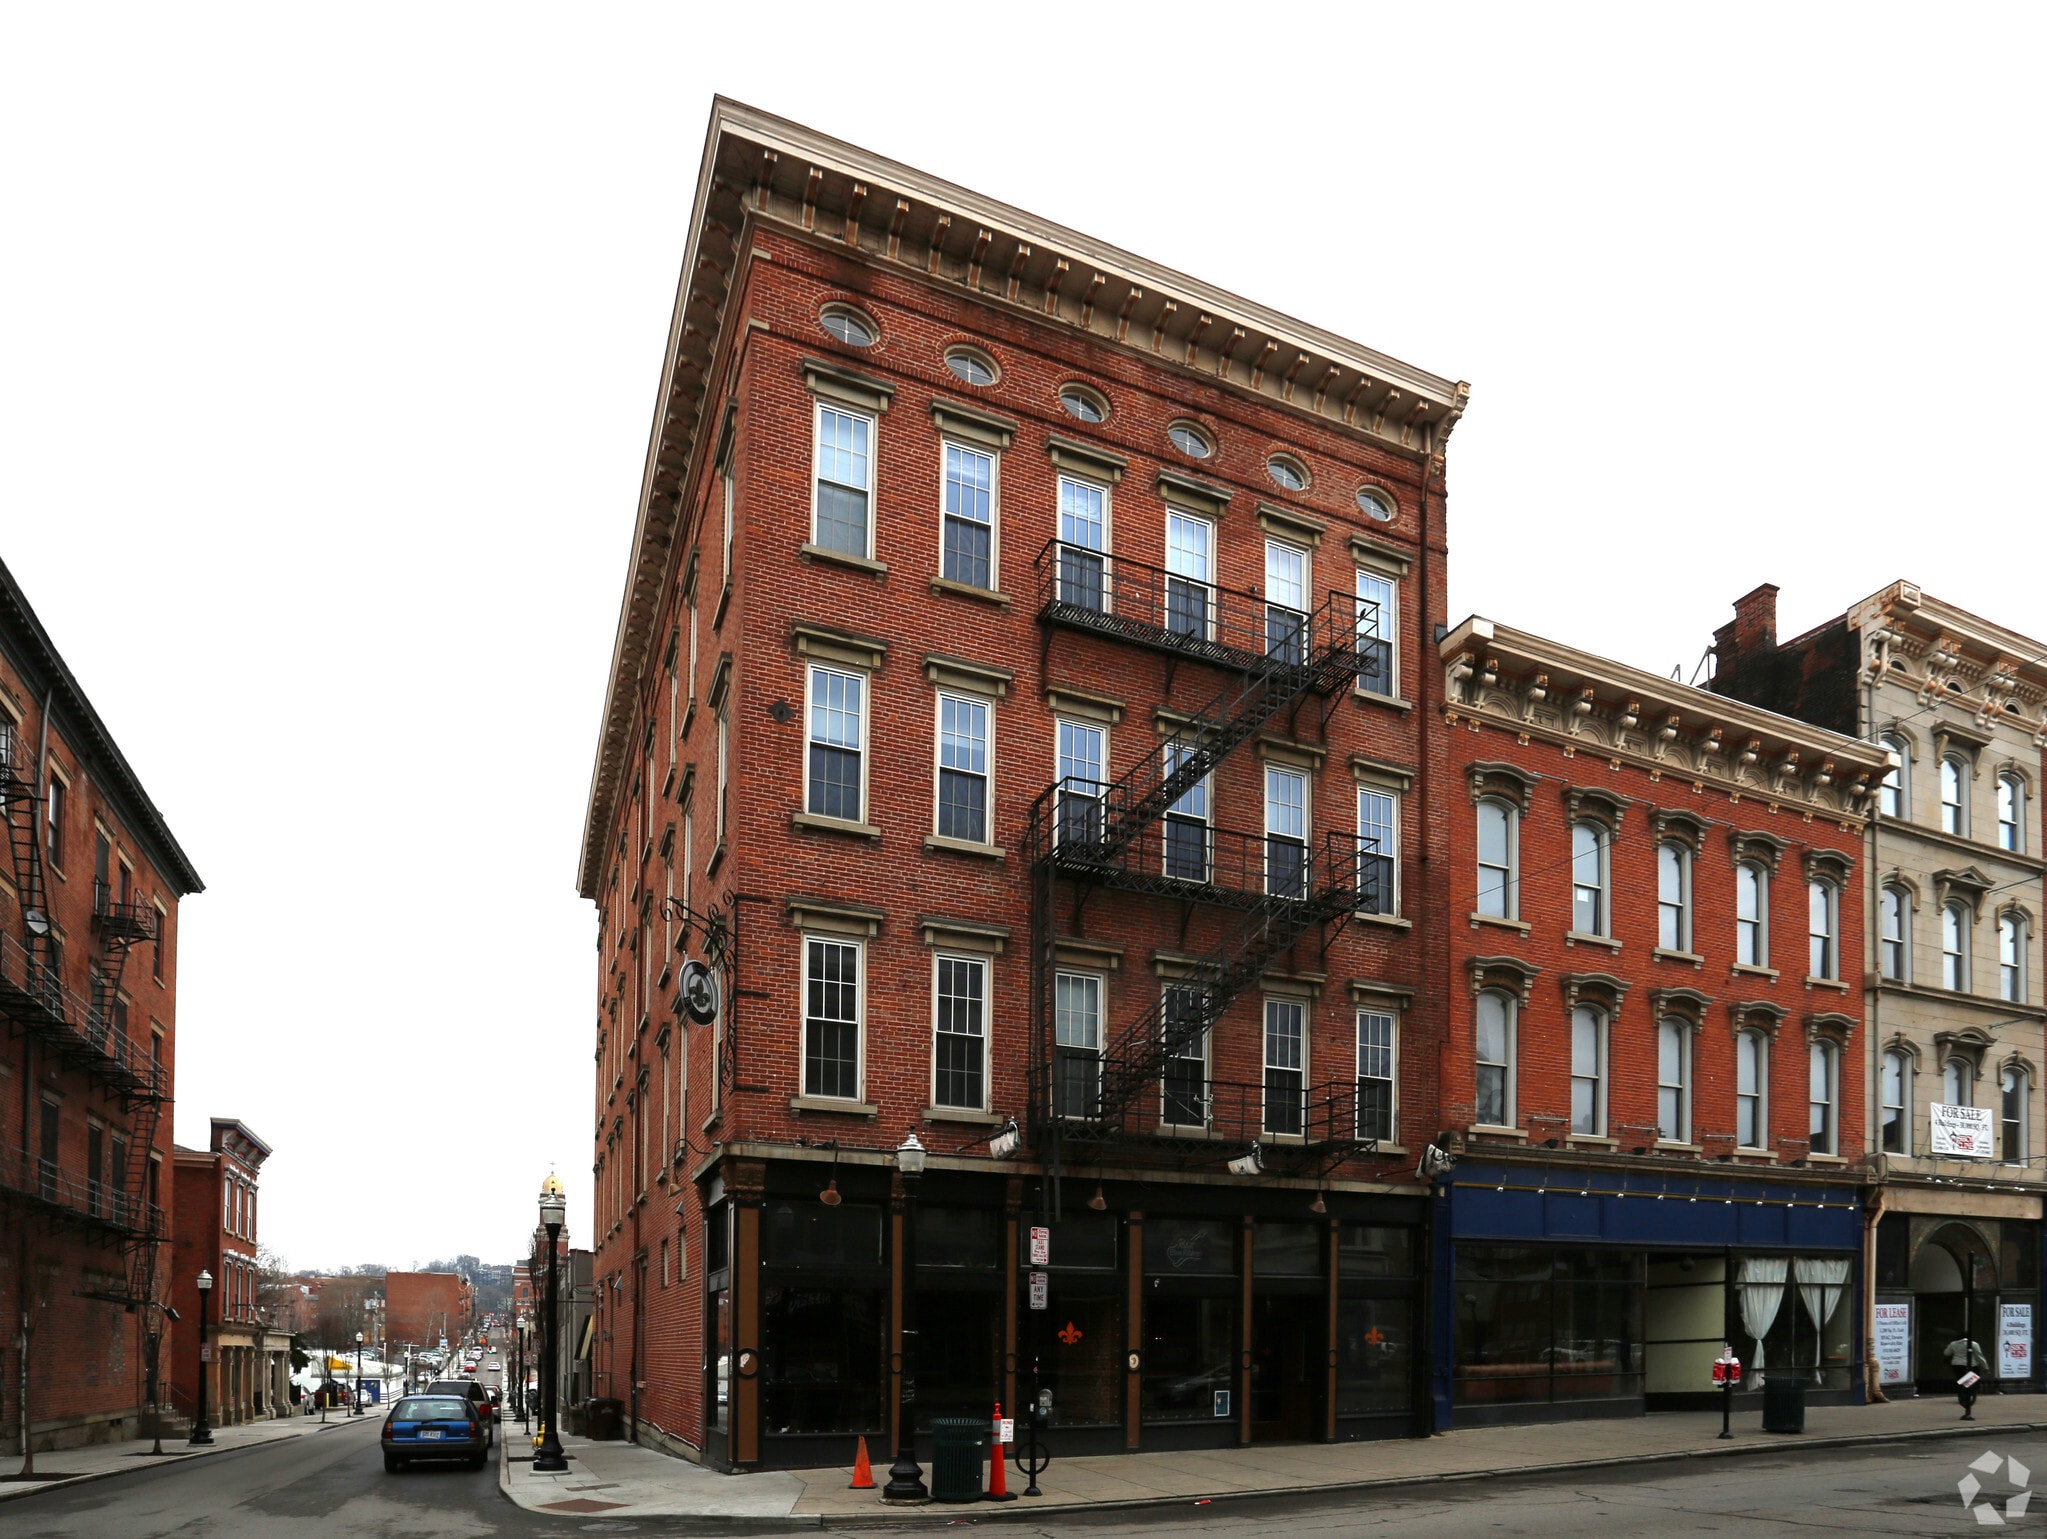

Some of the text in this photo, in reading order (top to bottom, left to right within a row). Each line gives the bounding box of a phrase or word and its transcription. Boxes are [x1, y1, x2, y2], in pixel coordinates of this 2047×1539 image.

[1942, 1106, 1982, 1121] FOR SALE
[1876, 1308, 1907, 1318] FOR LEASE
[2002, 1307, 2030, 1317] FOR SALE
